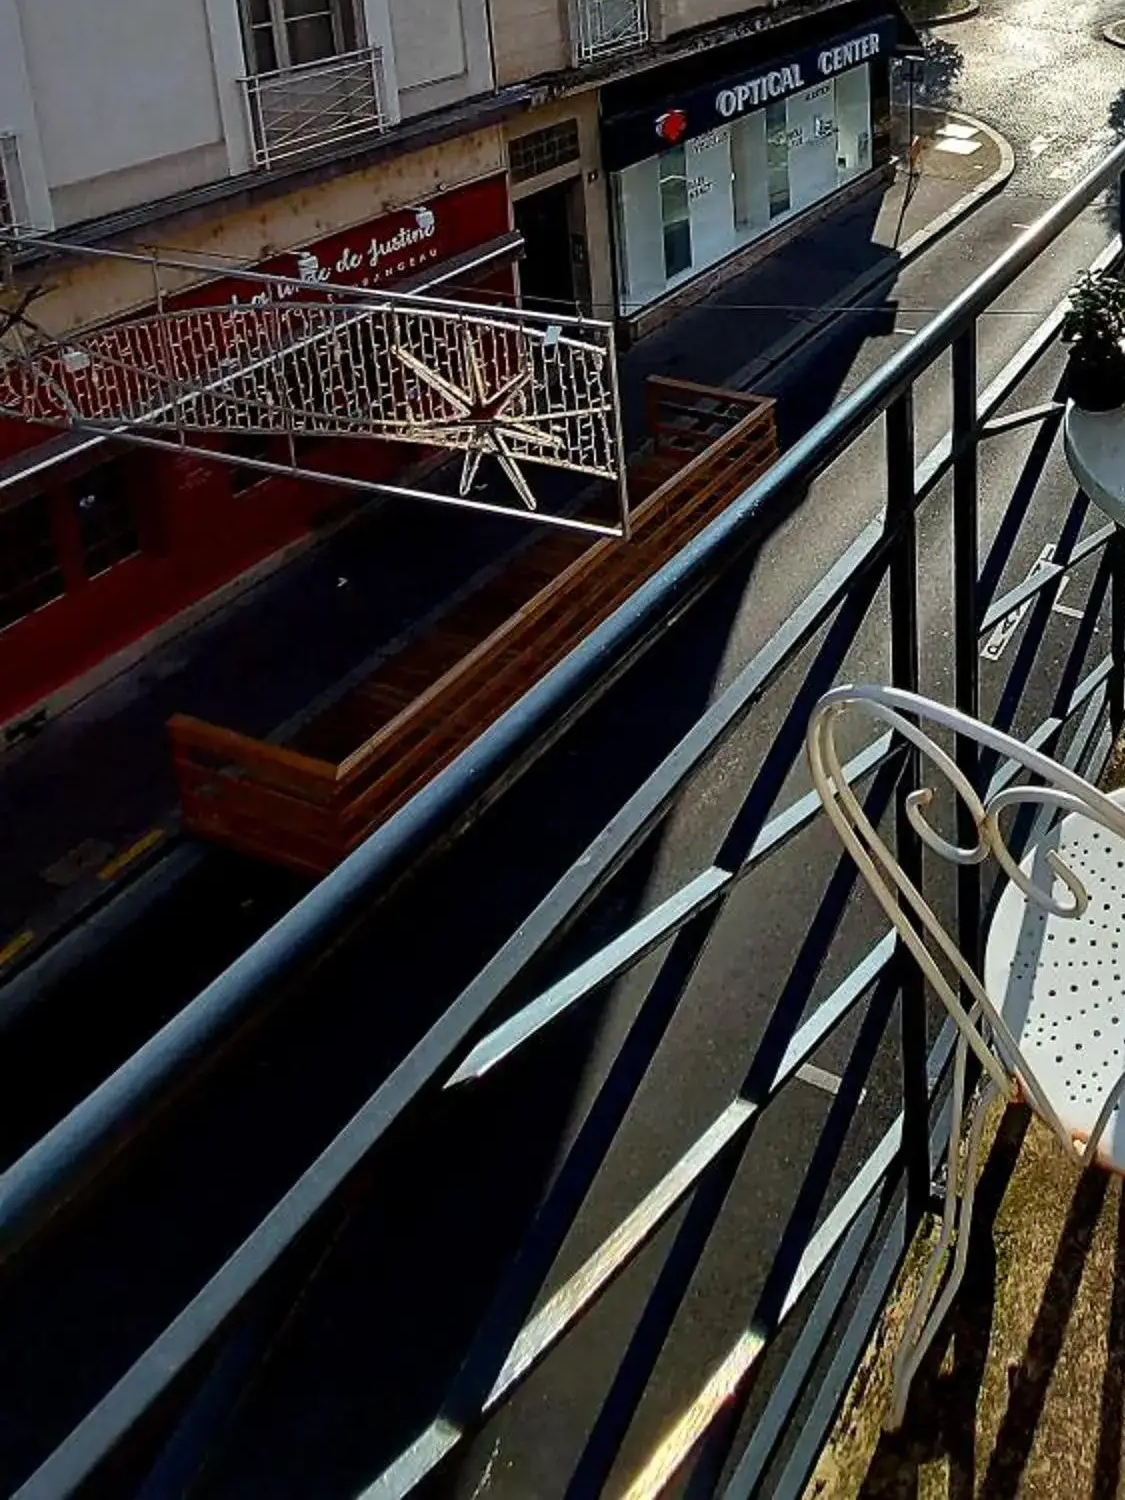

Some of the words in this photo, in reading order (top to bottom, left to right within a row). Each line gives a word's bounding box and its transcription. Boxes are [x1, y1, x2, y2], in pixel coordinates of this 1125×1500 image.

[715, 62, 805, 118] OPTICAL
[816, 32, 881, 76] CENTER
[335, 247, 363, 273] de
